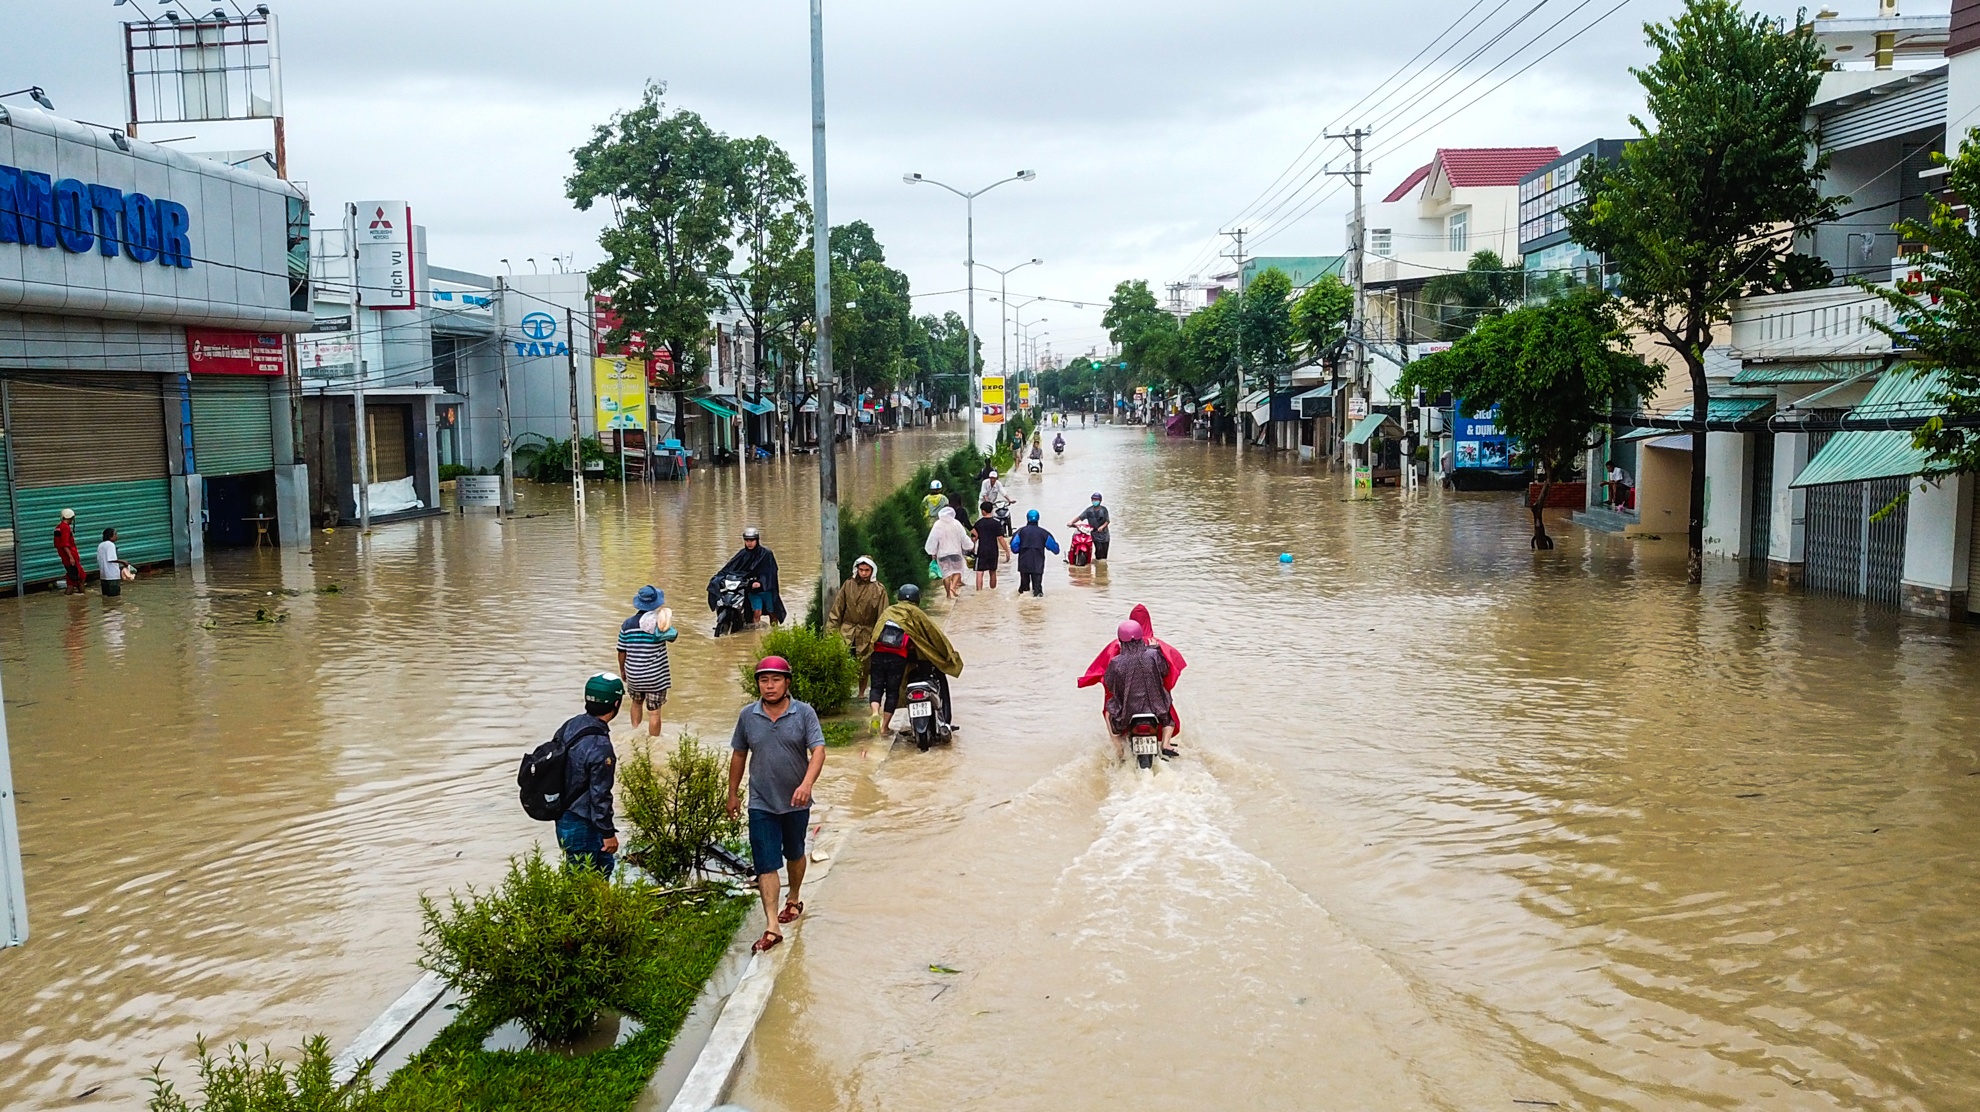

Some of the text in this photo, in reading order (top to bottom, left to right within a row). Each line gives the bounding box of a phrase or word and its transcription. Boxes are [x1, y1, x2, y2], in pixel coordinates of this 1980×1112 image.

[0, 164, 193, 268] MOTOR
[390, 250, 406, 298] Dịch vụ
[515, 341, 569, 357] TATA
[1466, 424, 1474, 435] &
